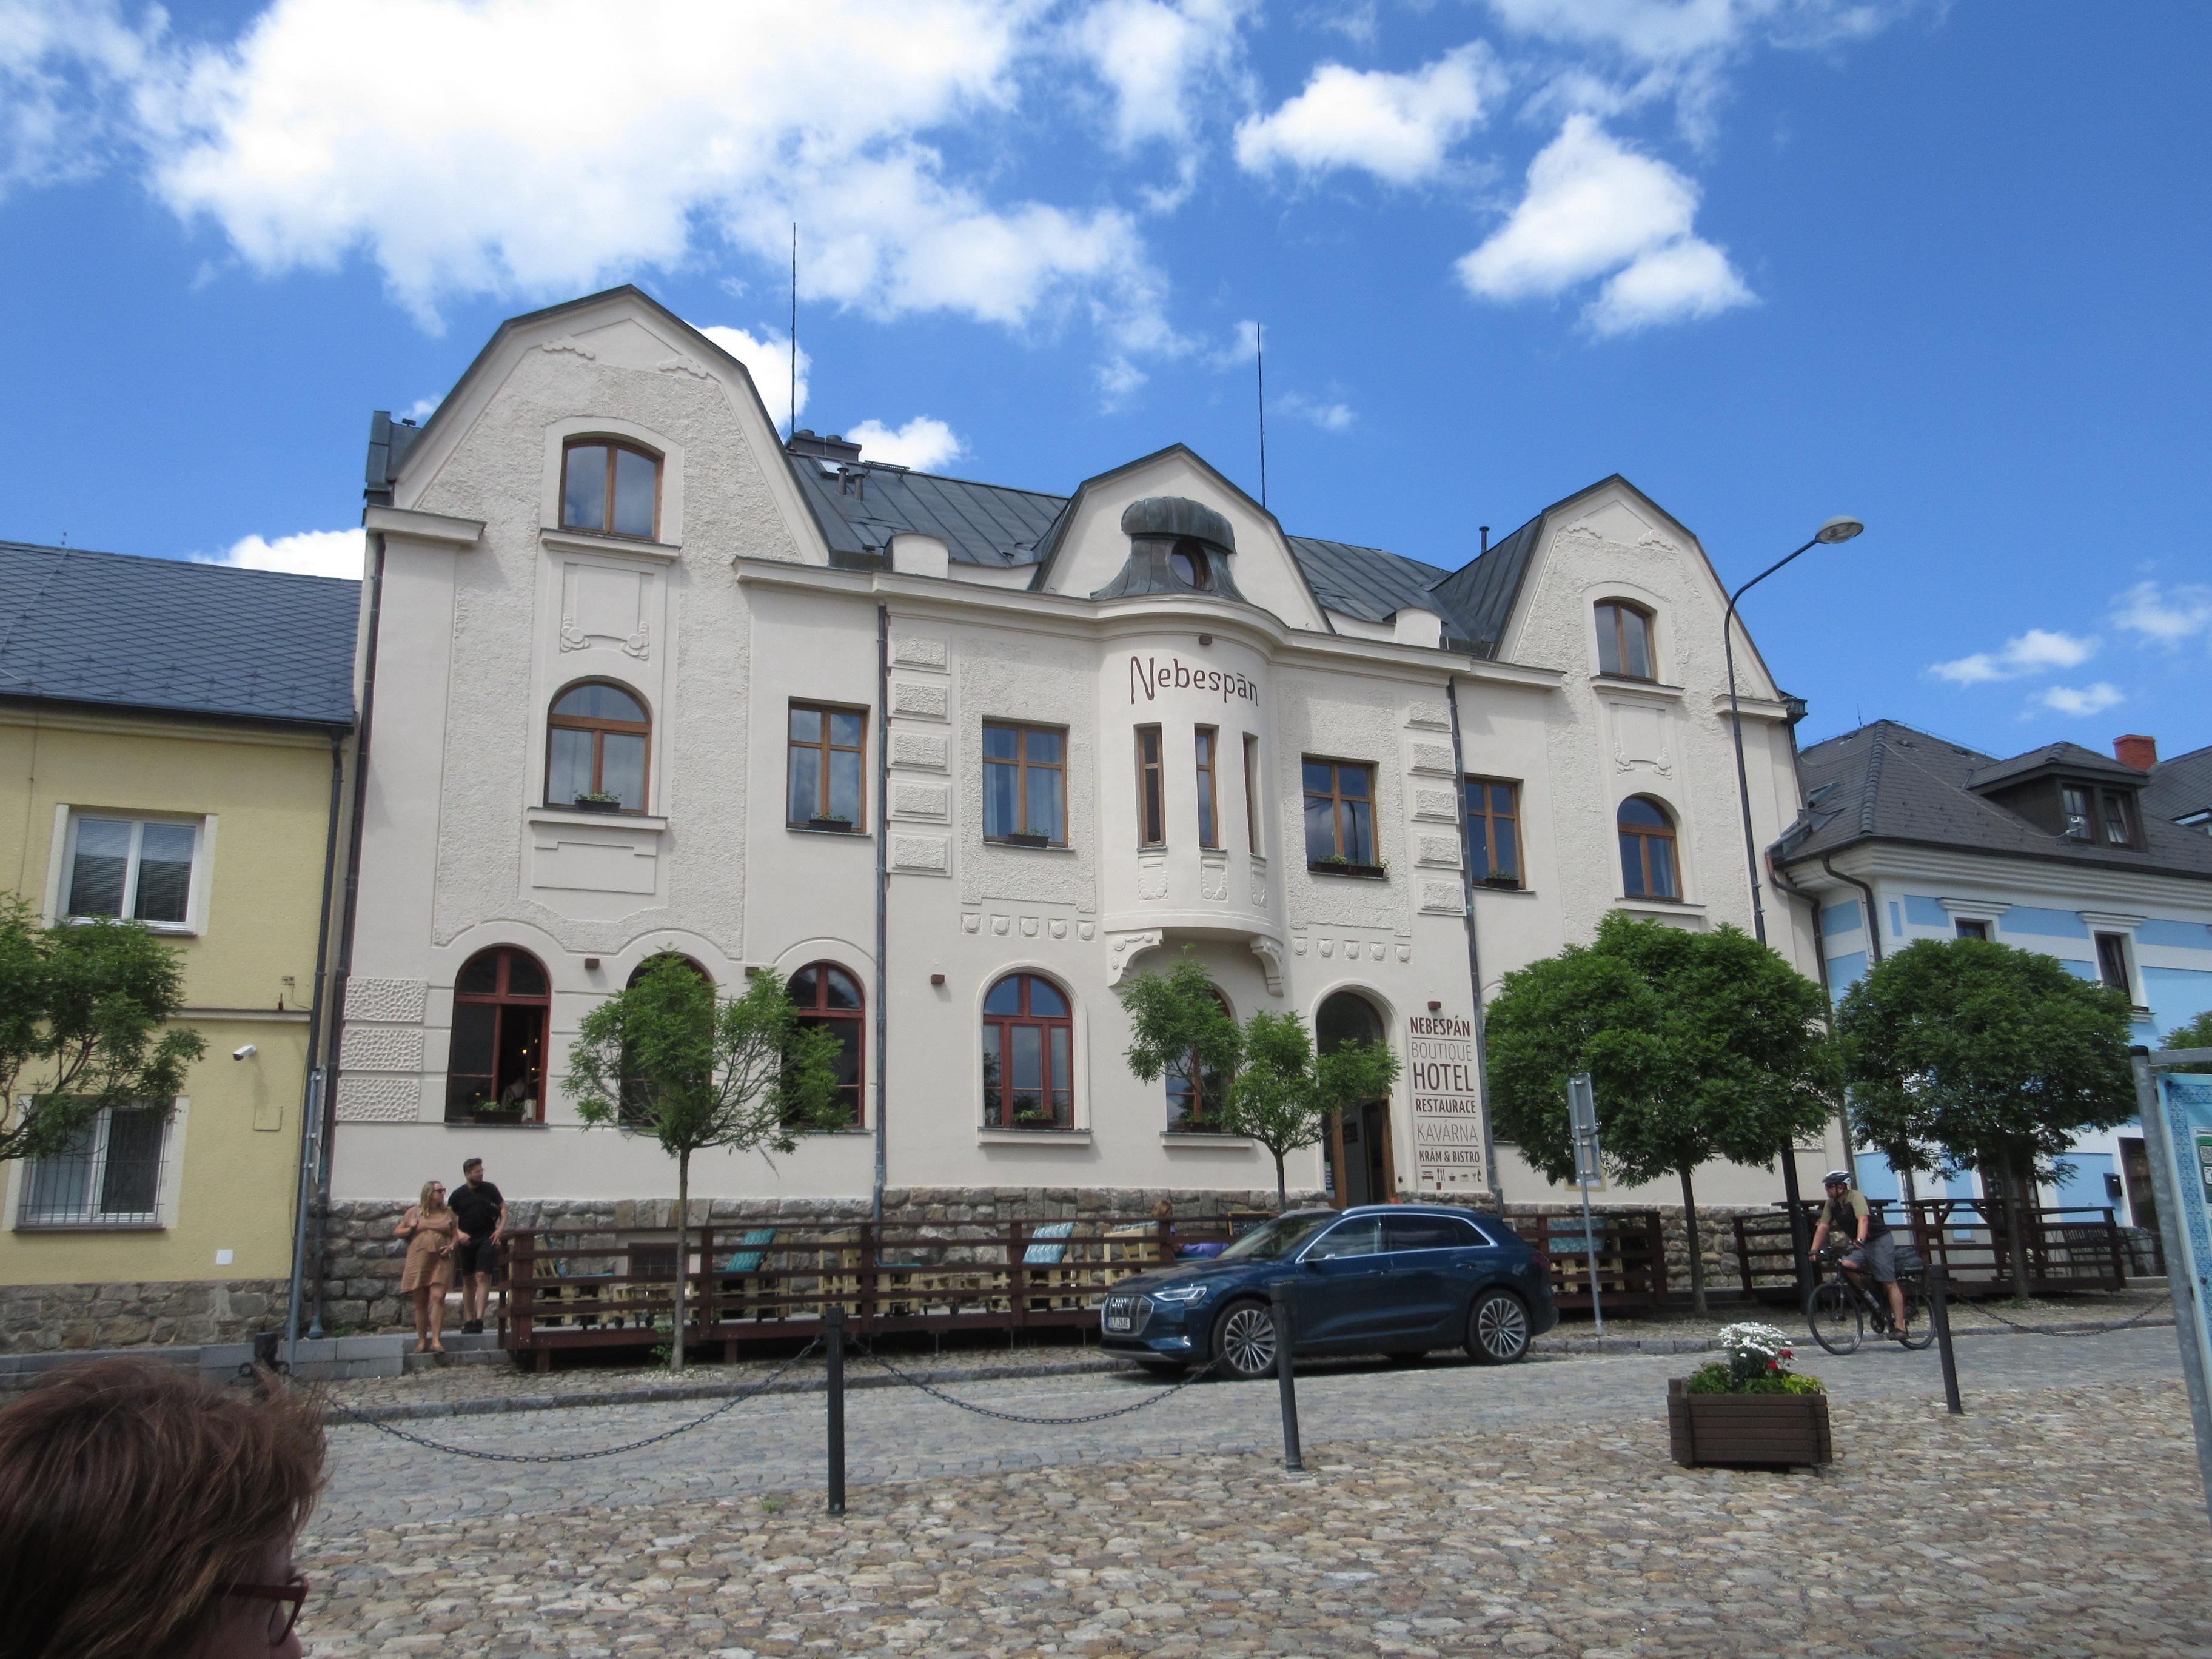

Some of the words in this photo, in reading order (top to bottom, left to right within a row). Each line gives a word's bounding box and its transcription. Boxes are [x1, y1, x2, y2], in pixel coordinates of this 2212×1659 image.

[1410, 1015, 1470, 1037] NEBESPÁN
[1411, 1042, 1472, 1063] BOUTIQUE
[1413, 1062, 1474, 1092] HOTEL
[1415, 1098, 1476, 1114] RESTAURACE
[1417, 1119, 1478, 1142] KAVÁRNA
[1419, 1147, 1442, 1162] KRÁM
[1444, 1151, 1450, 1162] &
[1452, 1151, 1480, 1163] BISTRO
